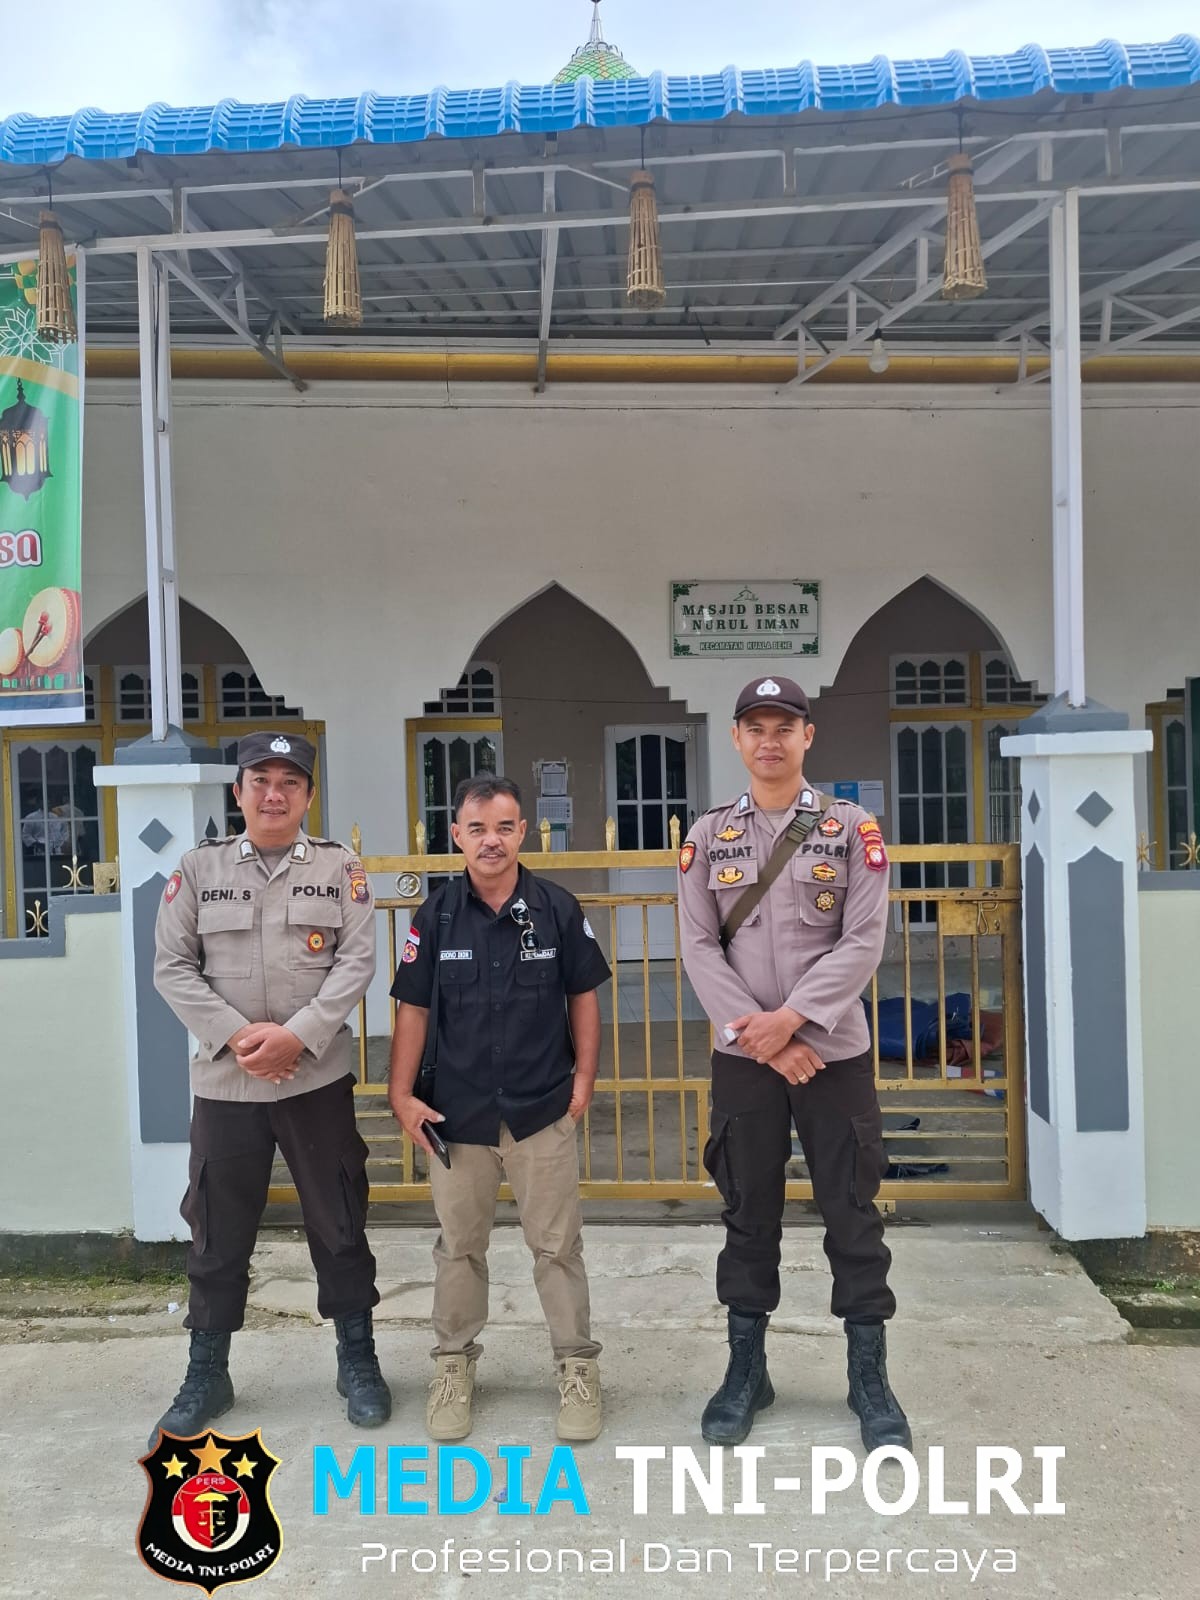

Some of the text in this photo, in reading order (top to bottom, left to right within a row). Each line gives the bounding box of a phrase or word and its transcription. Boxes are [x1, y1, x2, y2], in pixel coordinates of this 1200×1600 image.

[682, 603, 809, 616] MASJID BESAR
[692, 618, 800, 631] NURUL IMAN
[700, 641, 744, 650] KECAMATAN
[709, 846, 753, 862] GOLIAT
[801, 843, 850, 859] POLRI
[201, 889, 251, 902] DENI. S
[292, 885, 340, 899] POLRI
